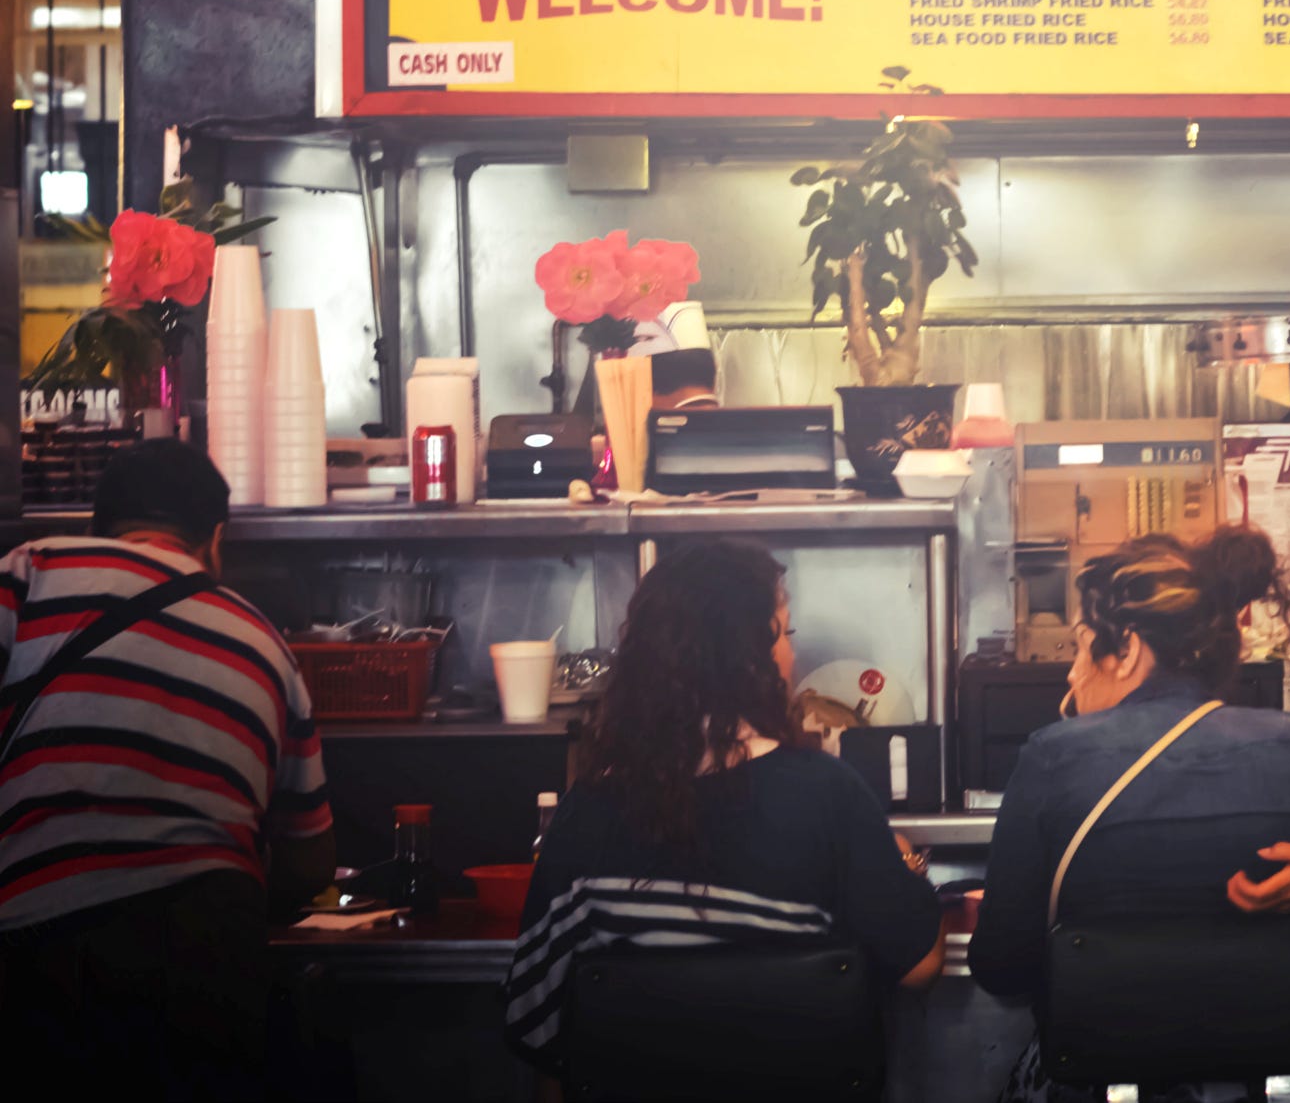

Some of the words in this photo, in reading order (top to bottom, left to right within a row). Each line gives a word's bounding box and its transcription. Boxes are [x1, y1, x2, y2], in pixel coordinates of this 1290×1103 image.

[910, 14, 974, 27] HOUSE
[982, 14, 1036, 26] FRIED
[1043, 14, 1086, 26] RICE
[911, 32, 948, 45] SEA
[956, 32, 1006, 45] FOOD
[1013, 32, 1067, 45] FRIED
[1074, 32, 1117, 45] RICE
[399, 53, 447, 74] CASH
[457, 52, 502, 73] ONLY
